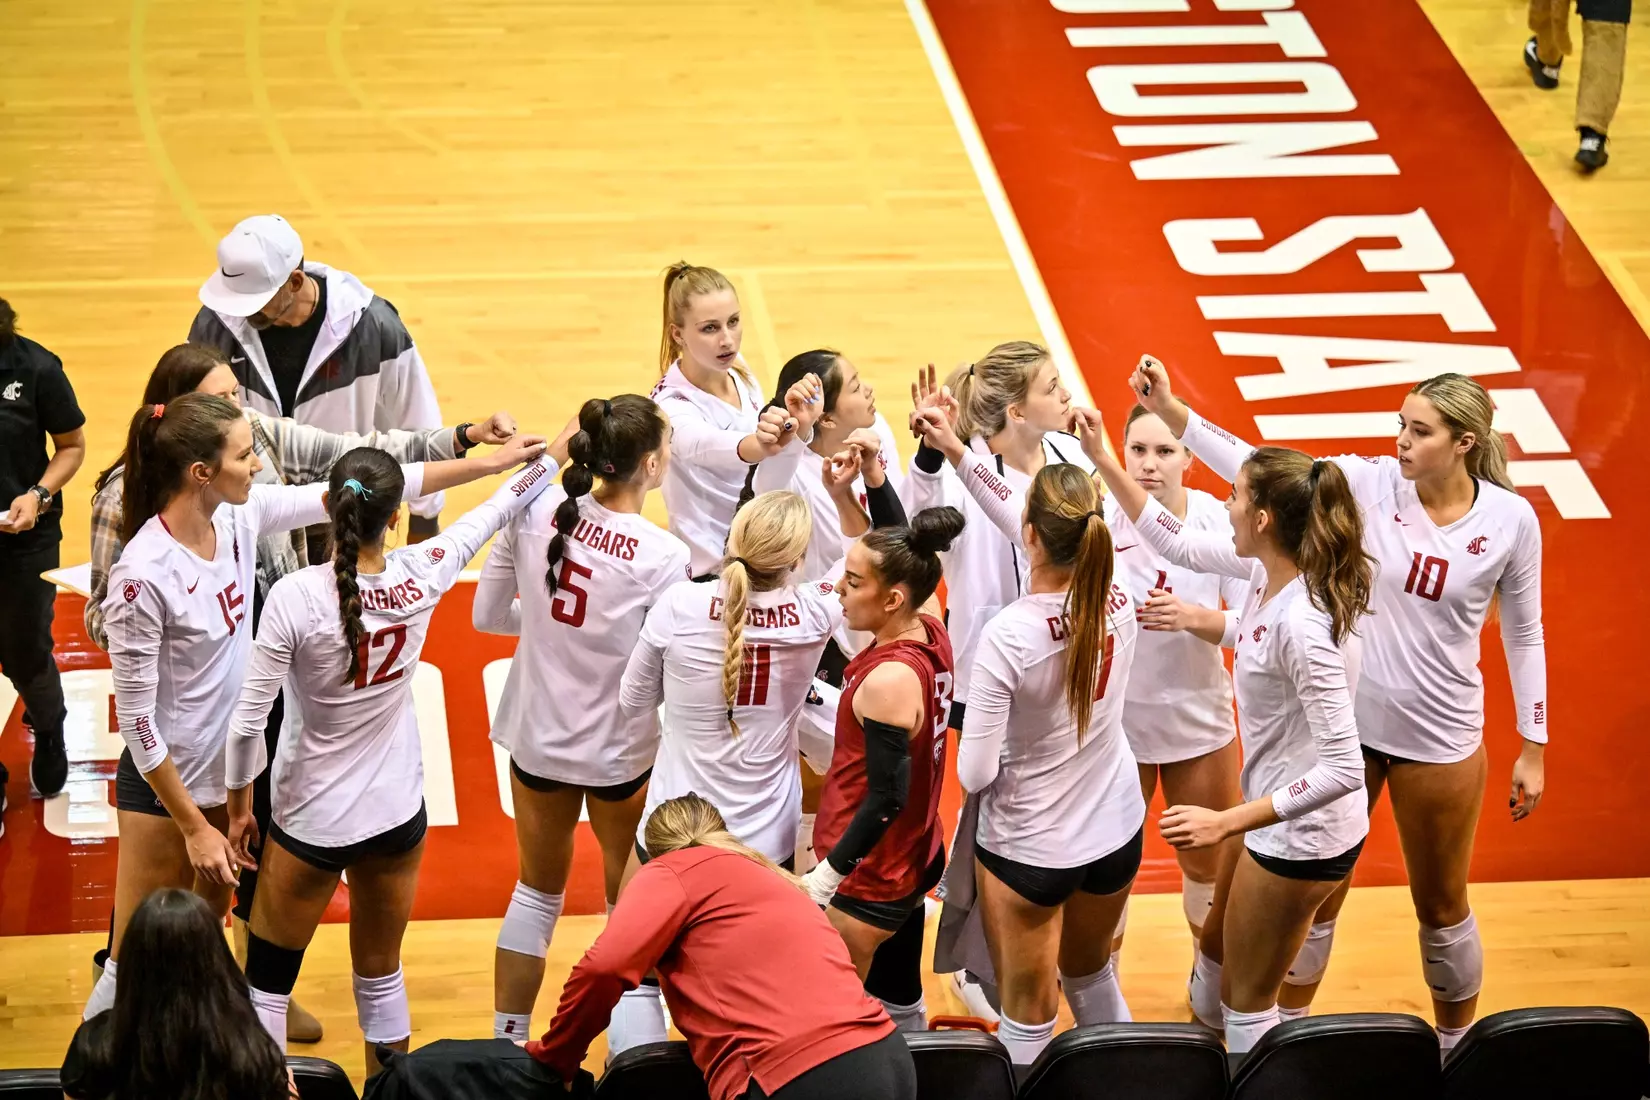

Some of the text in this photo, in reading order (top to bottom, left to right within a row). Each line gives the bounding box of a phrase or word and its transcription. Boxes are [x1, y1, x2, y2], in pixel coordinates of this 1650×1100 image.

[1048, 0, 1400, 180] TON
[510, 462, 547, 498] COUGARS
[973, 462, 1013, 502] COUGARS
[551, 516, 640, 562] UGARS
[551, 557, 593, 628] 5
[1404, 551, 1449, 602] 10
[216, 580, 245, 637] 15
[353, 623, 407, 691] 12
[736, 644, 771, 706] 11
[134, 715, 157, 752] COUGS
[1533, 701, 1544, 725] WSU
[1288, 778, 1311, 798] WSU
